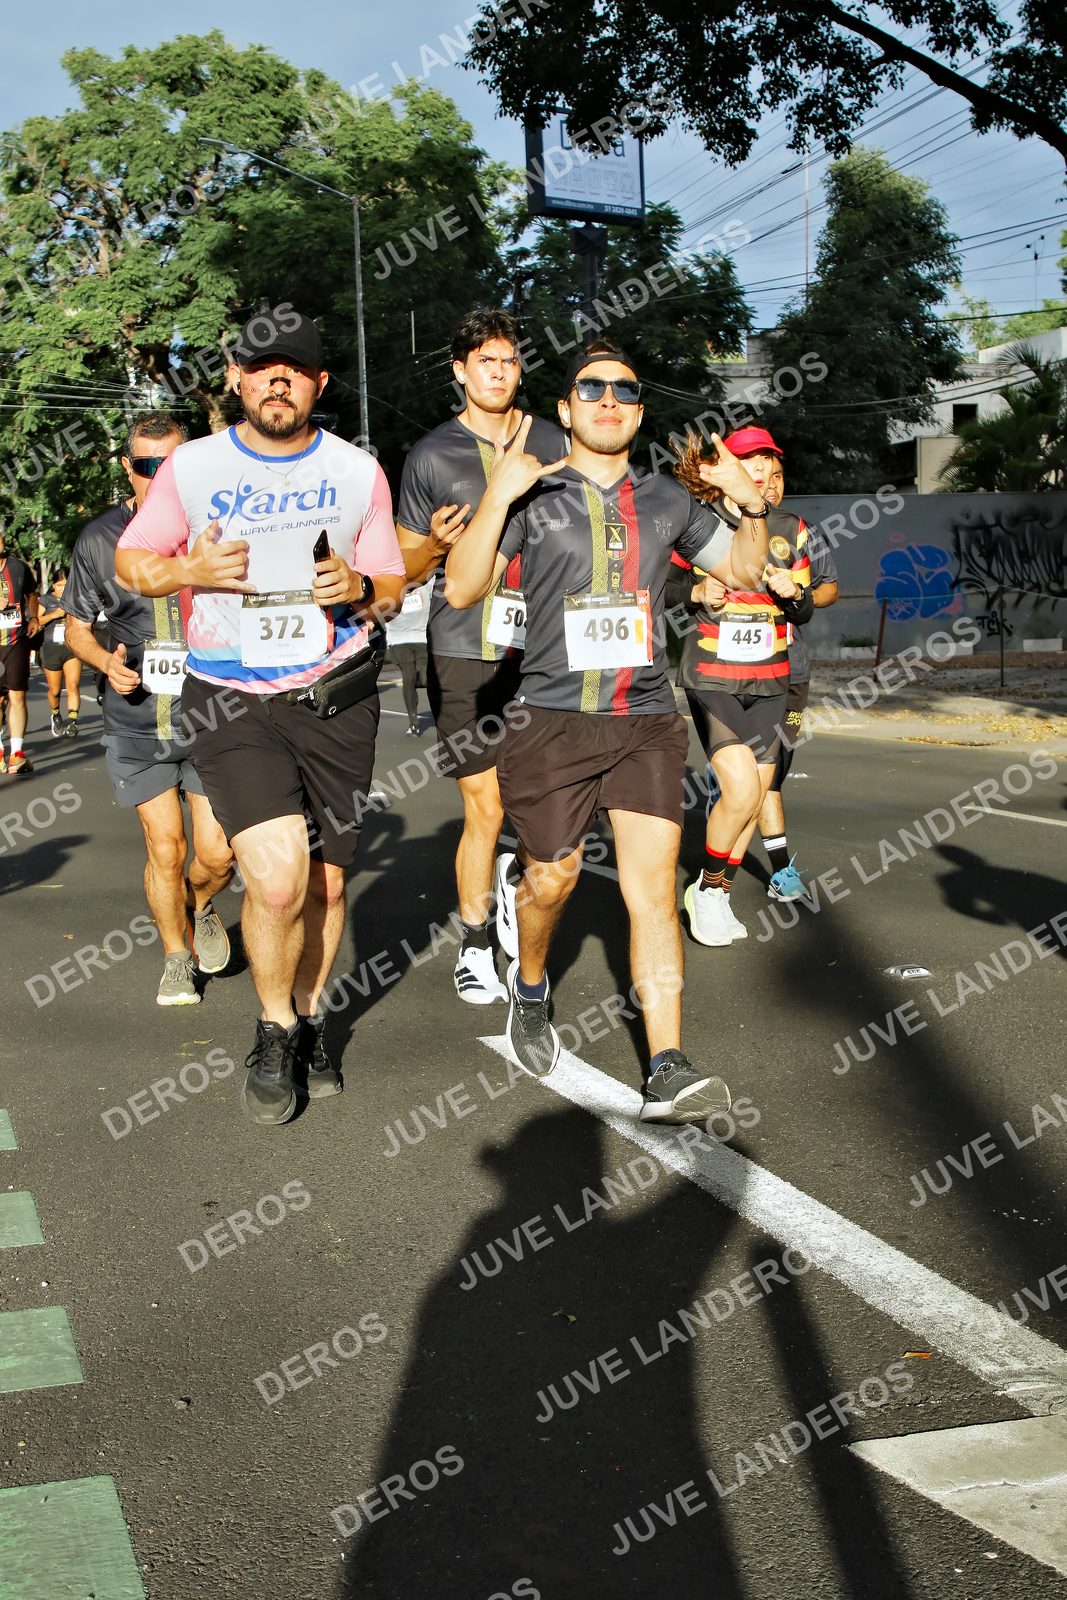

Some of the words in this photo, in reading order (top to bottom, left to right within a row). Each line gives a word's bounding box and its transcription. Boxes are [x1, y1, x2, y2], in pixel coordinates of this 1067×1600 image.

[240, 524, 279, 537] WAVE
[281, 515, 341, 531] RUNNERS
[259, 614, 305, 641] 372
[502, 606, 528, 628] 50
[583, 616, 630, 642] 496
[731, 628, 762, 645] 445
